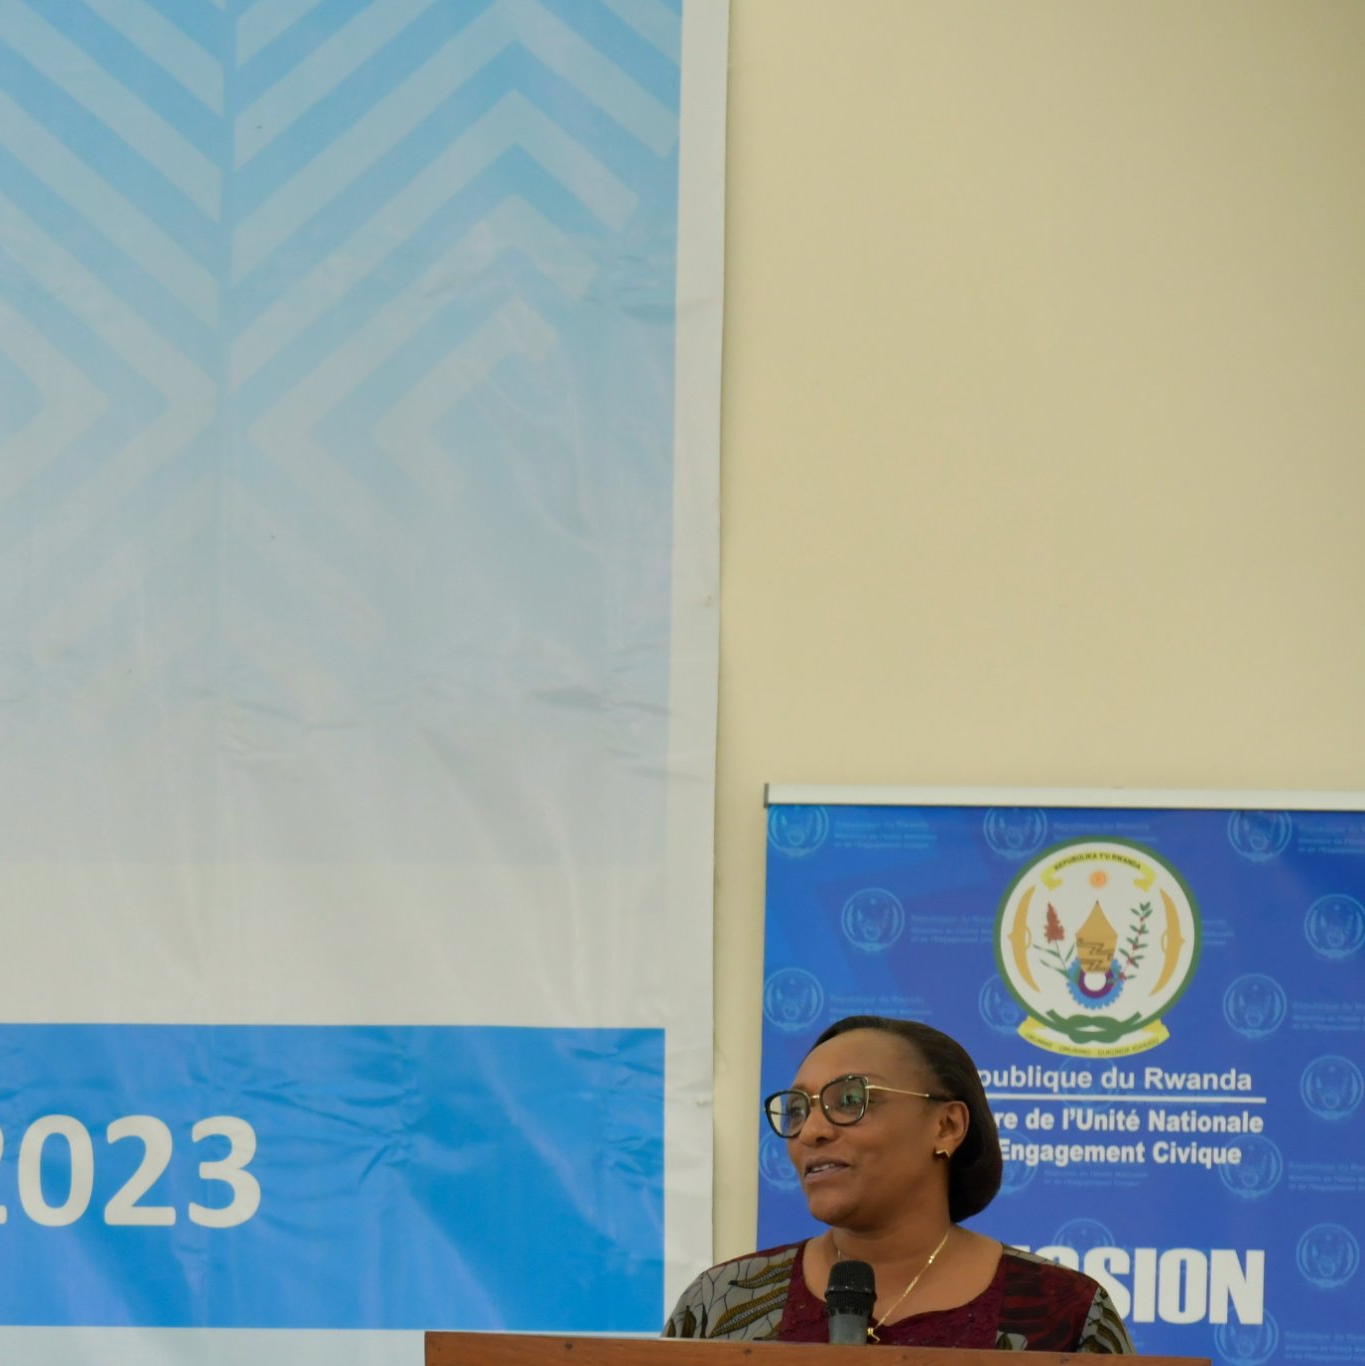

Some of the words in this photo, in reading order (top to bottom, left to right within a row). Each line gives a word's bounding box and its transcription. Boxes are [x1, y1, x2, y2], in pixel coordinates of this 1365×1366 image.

[977, 1065, 1093, 1094] publique
[1101, 1066, 1135, 1089] du
[1144, 1067, 1252, 1091] Rwanda
[1025, 1107, 1055, 1131] de
[1148, 1109, 1264, 1134] Nationale
[1000, 1139, 1146, 1168] Engagement
[1152, 1140, 1242, 1170] Civique
[1014, 1245, 1265, 1326] SION
